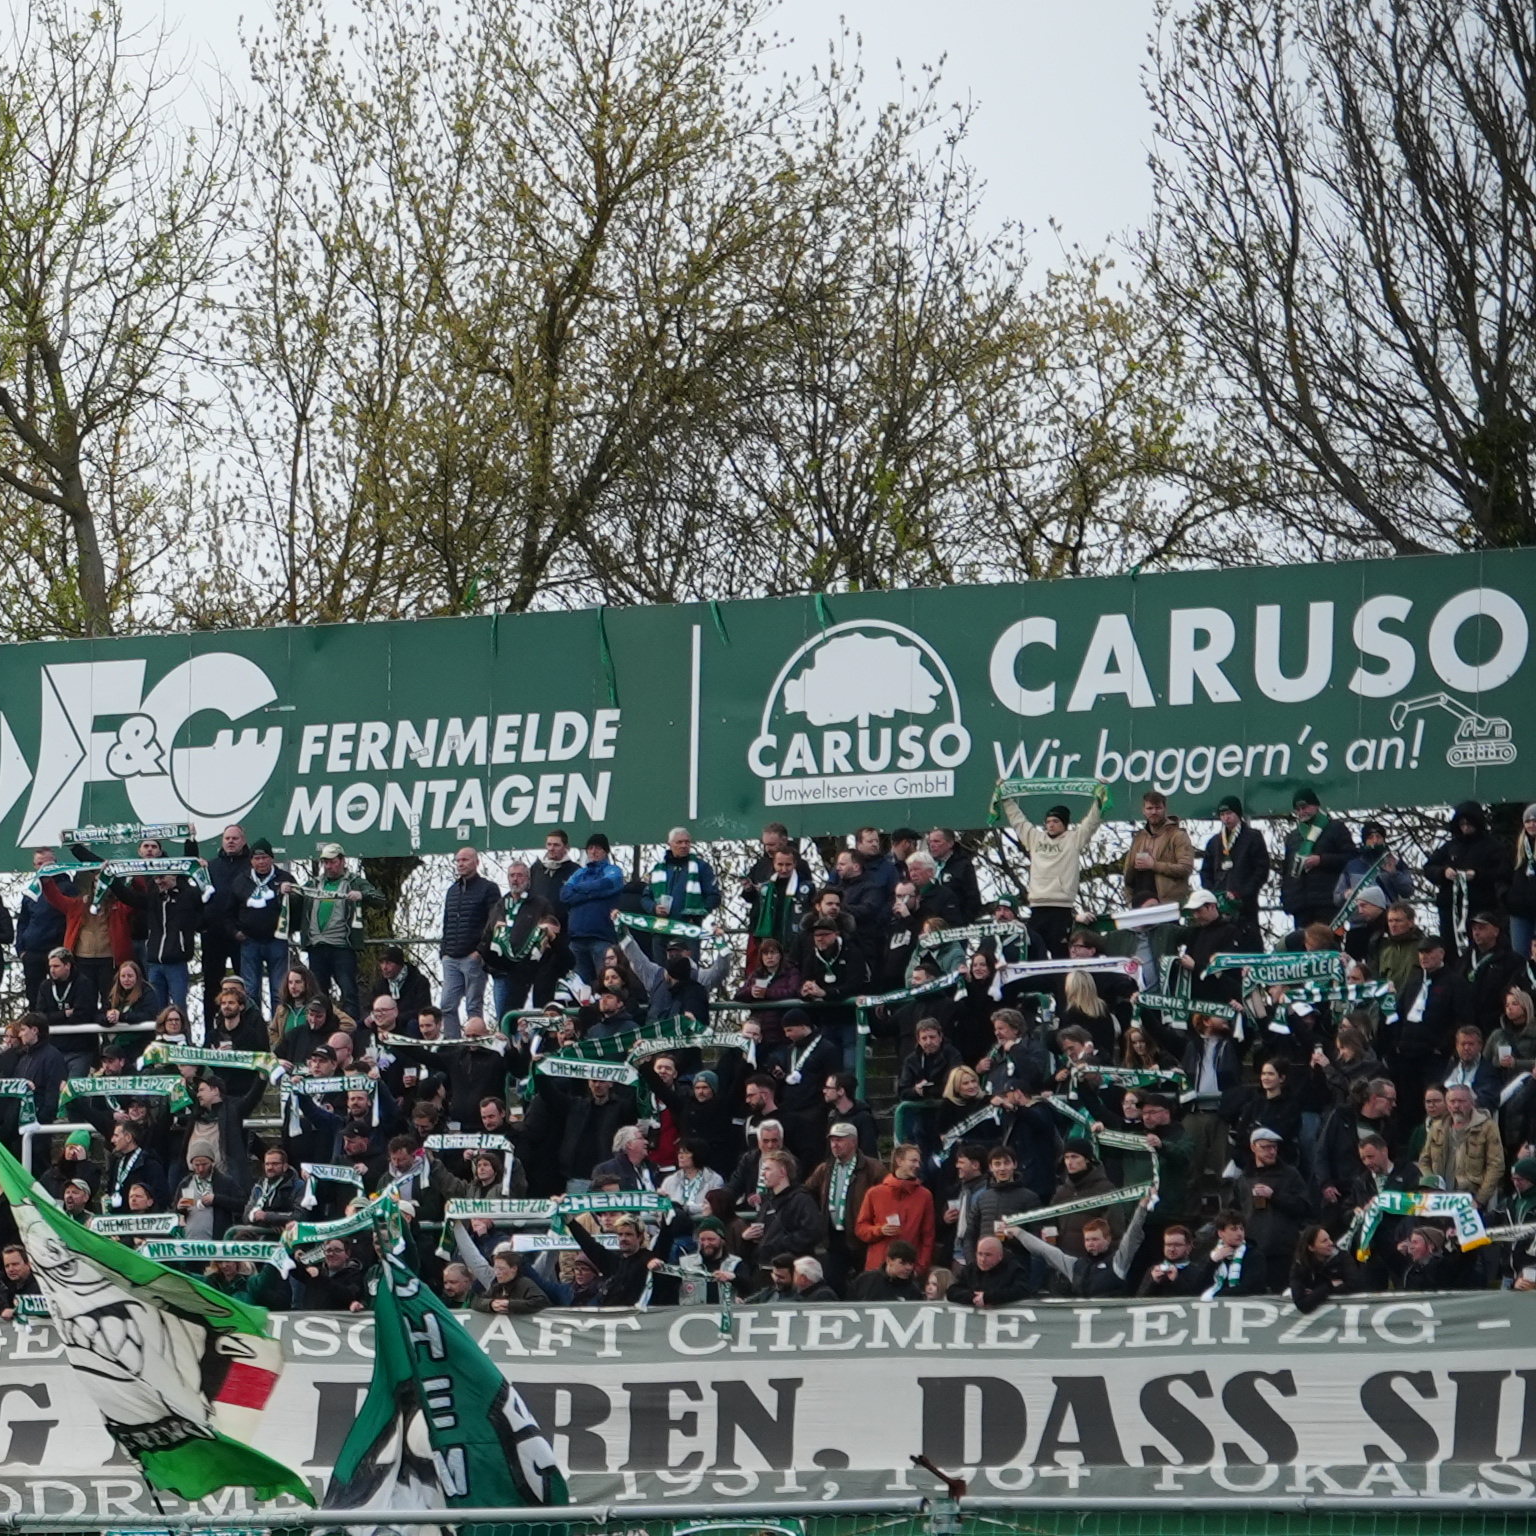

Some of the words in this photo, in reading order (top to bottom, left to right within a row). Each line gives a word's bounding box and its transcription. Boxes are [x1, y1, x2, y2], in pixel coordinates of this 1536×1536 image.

[990, 588, 1529, 716] CARUSO
[298, 708, 621, 774] FERNMELDE
[748, 722, 971, 777] CARUSO
[993, 738, 1081, 781] Wir
[1094, 726, 1327, 795] baggern's
[1345, 719, 1423, 770] an!
[282, 772, 612, 835] MONTAGEN
[771, 779, 887, 802] Umweltservice
[893, 774, 949, 797] GmbH
[668, 1306, 1040, 1354] CHEMIE
[1071, 1302, 1442, 1348] LEIPZIG
[918, 1370, 1298, 1468] DASS
